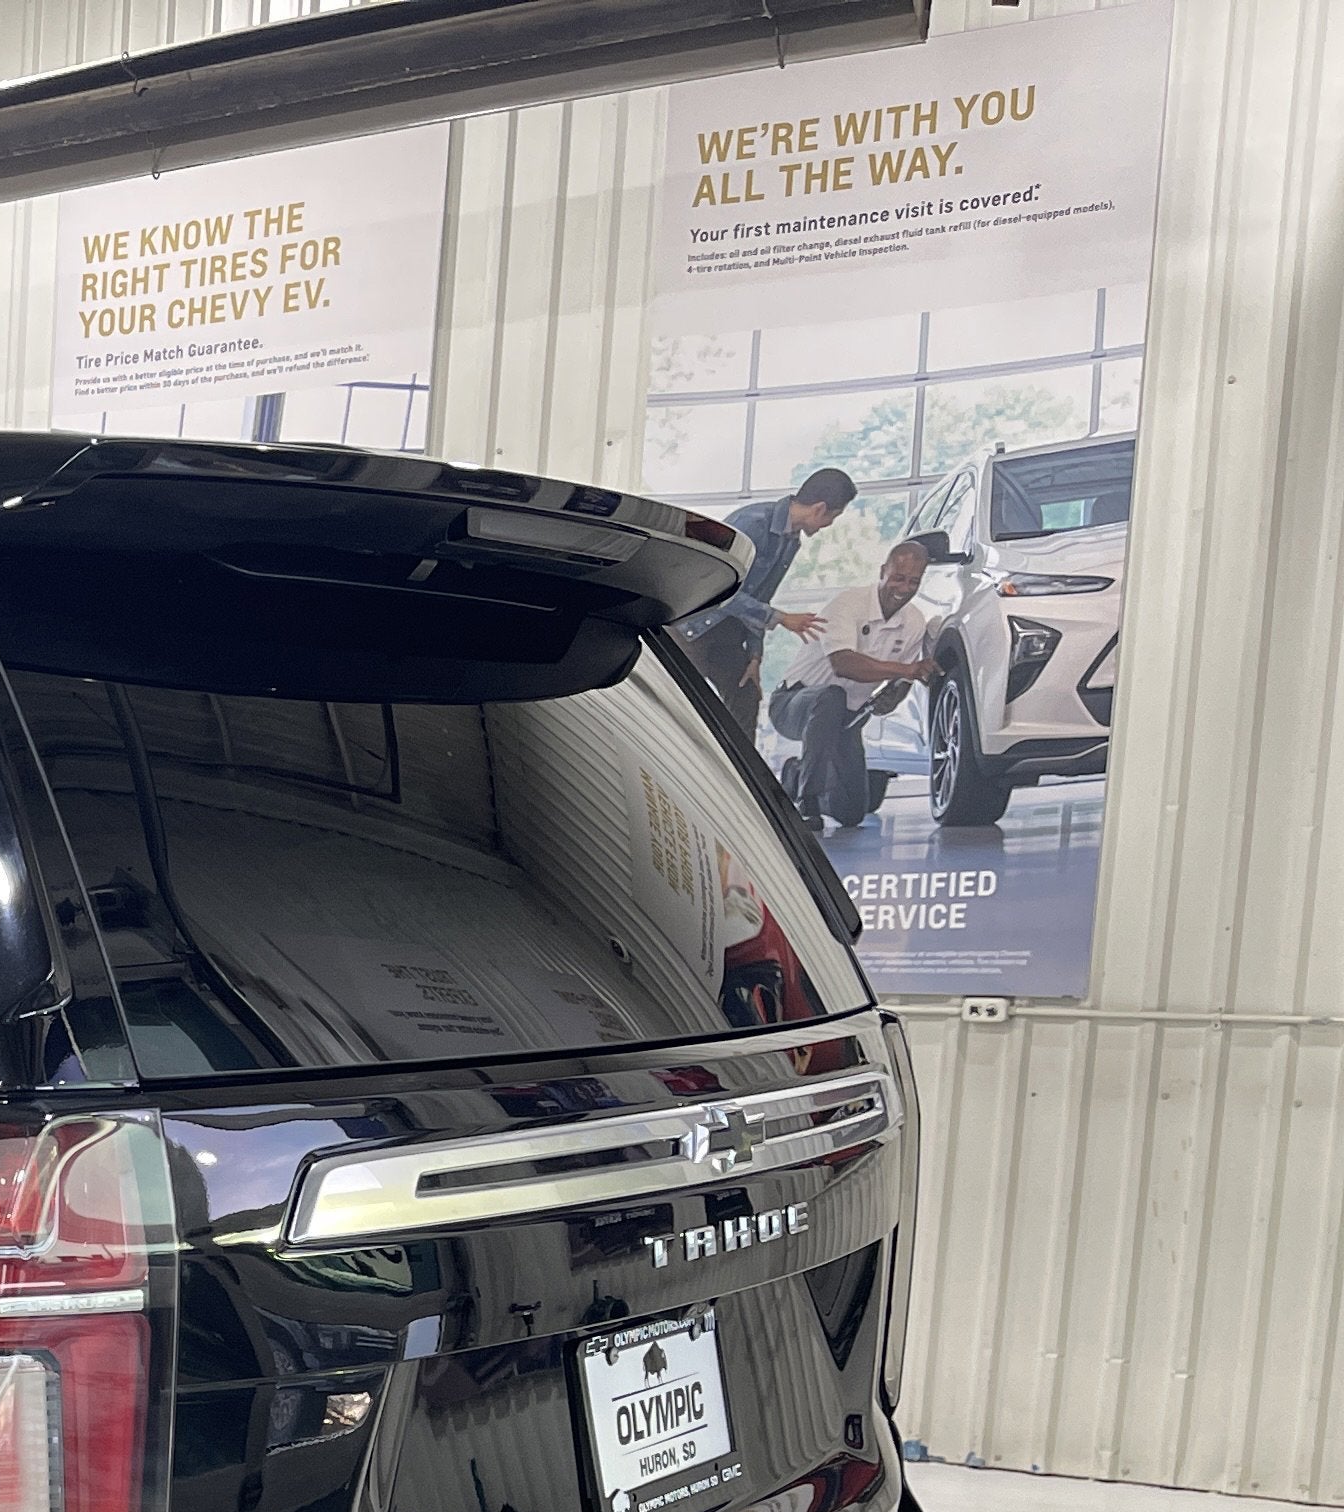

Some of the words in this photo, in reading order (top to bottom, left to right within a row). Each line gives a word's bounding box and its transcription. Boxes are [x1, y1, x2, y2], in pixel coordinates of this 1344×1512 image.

[698, 117, 820, 164] WE'RE
[834, 100, 938, 147] WITH
[953, 85, 1035, 129] YOU
[692, 169, 765, 208] ALL
[779, 156, 855, 197] THE
[868, 141, 964, 186] WAY.
[83, 231, 130, 264] WE
[139, 214, 234, 257] KNOW
[243, 202, 305, 240] THE
[690, 227, 729, 244] Your
[733, 222, 771, 240] first
[776, 209, 890, 235] maintenance
[895, 201, 933, 220] visit
[939, 198, 954, 215] is
[741, 247, 758, 258] and
[772, 244, 795, 254] filter
[797, 241, 833, 253] change,
[834, 236, 862, 247] diesel
[863, 231, 901, 244] exhaust
[902, 228, 923, 239] fluid
[925, 225, 947, 236] tank
[948, 221, 972, 233] refill
[973, 219, 990, 231] (for
[993, 207, 1071, 227] diesel-equipped
[81, 263, 170, 302] RIGHT
[180, 248, 268, 289] TIRES
[280, 236, 341, 275] FOR
[754, 258, 771, 268] and
[772, 253, 822, 267] Multi-Point
[823, 249, 857, 261] Vehicle
[79, 303, 156, 339] YOUR
[168, 285, 273, 329] CHEVY
[283, 278, 330, 314] EV.
[76, 354, 102, 369] Tire
[105, 353, 140, 367] Price
[143, 345, 184, 363] Match
[188, 337, 264, 357] Guarantee.
[842, 870, 997, 900] CERTIFIED
[859, 903, 967, 931] ERVICE
[643, 1201, 810, 1269] TAHOE
[617, 1381, 704, 1446] OLYMPIC
[639, 1447, 680, 1477] HURON,
[682, 1440, 696, 1461] SD
